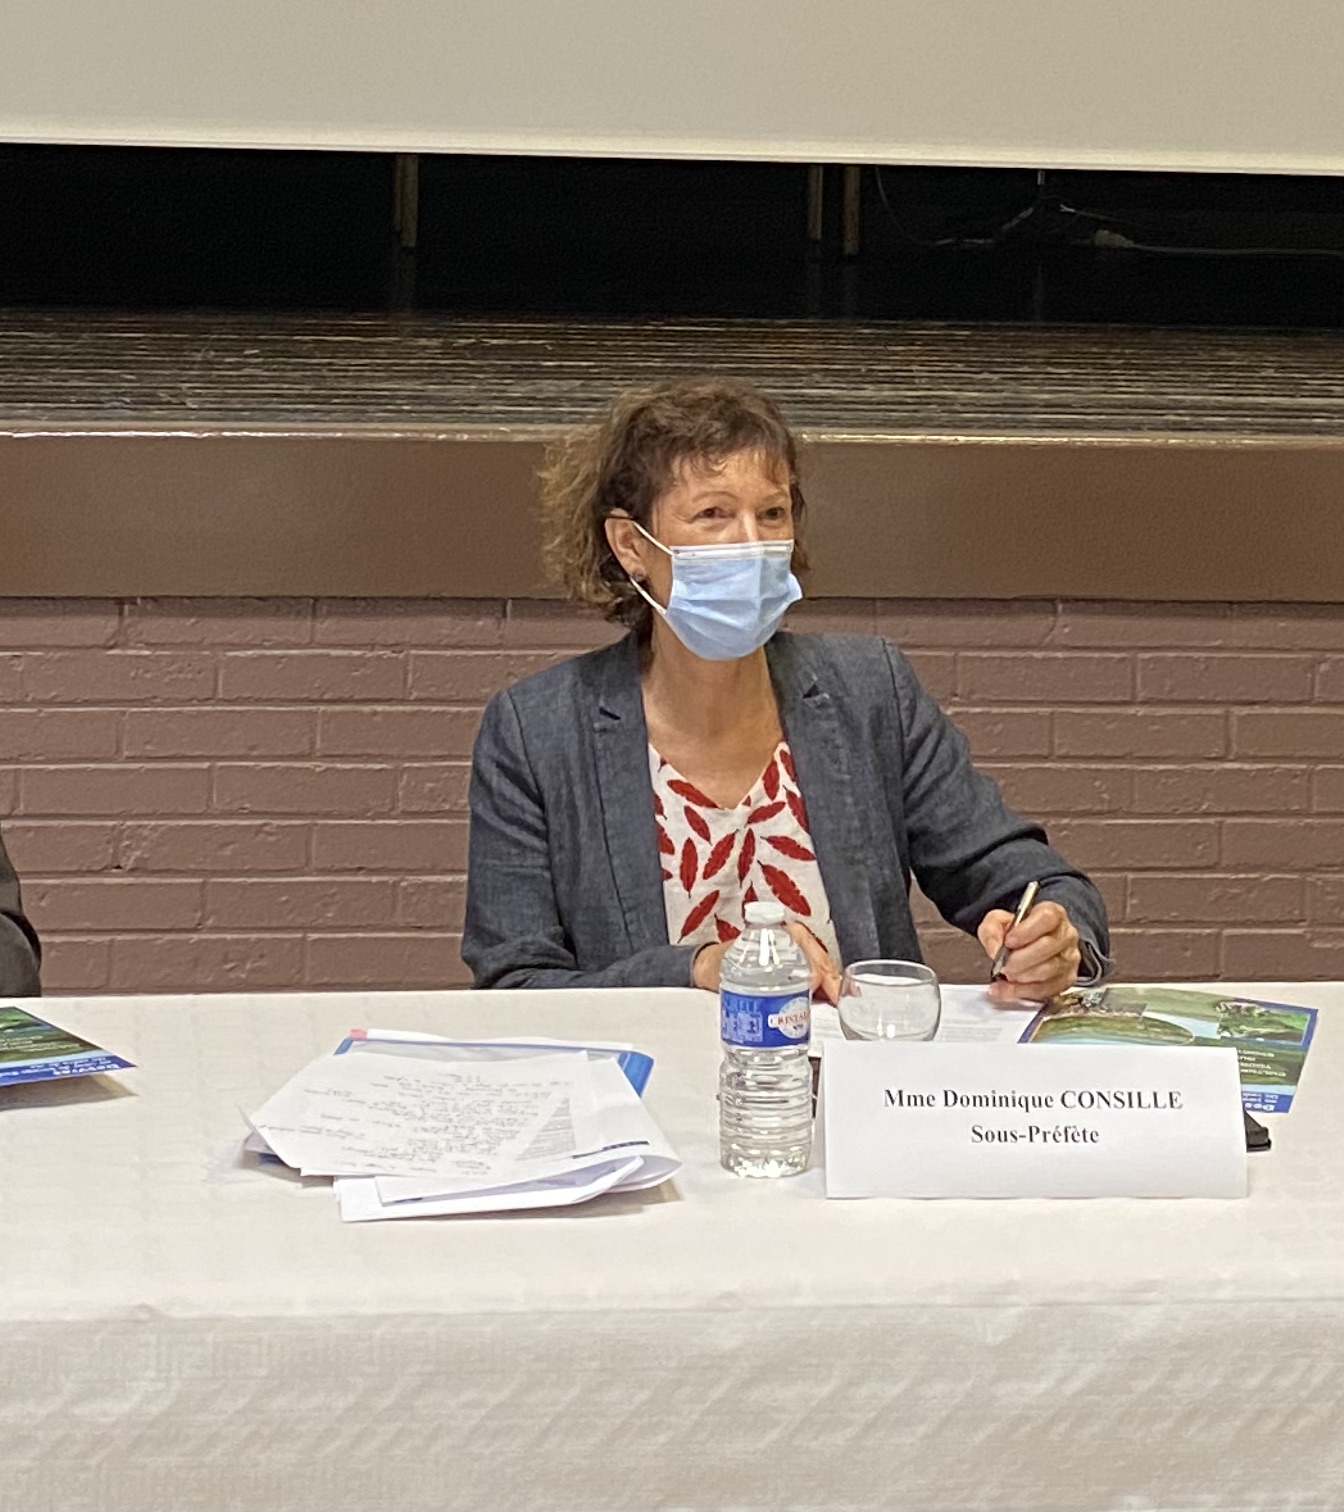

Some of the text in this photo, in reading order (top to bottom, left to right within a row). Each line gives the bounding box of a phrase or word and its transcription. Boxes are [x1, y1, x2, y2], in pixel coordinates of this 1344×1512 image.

[884, 1088, 1184, 1112] Mme Dominique CONSILLE
[970, 1124, 1101, 1144] Sous-Préfète
